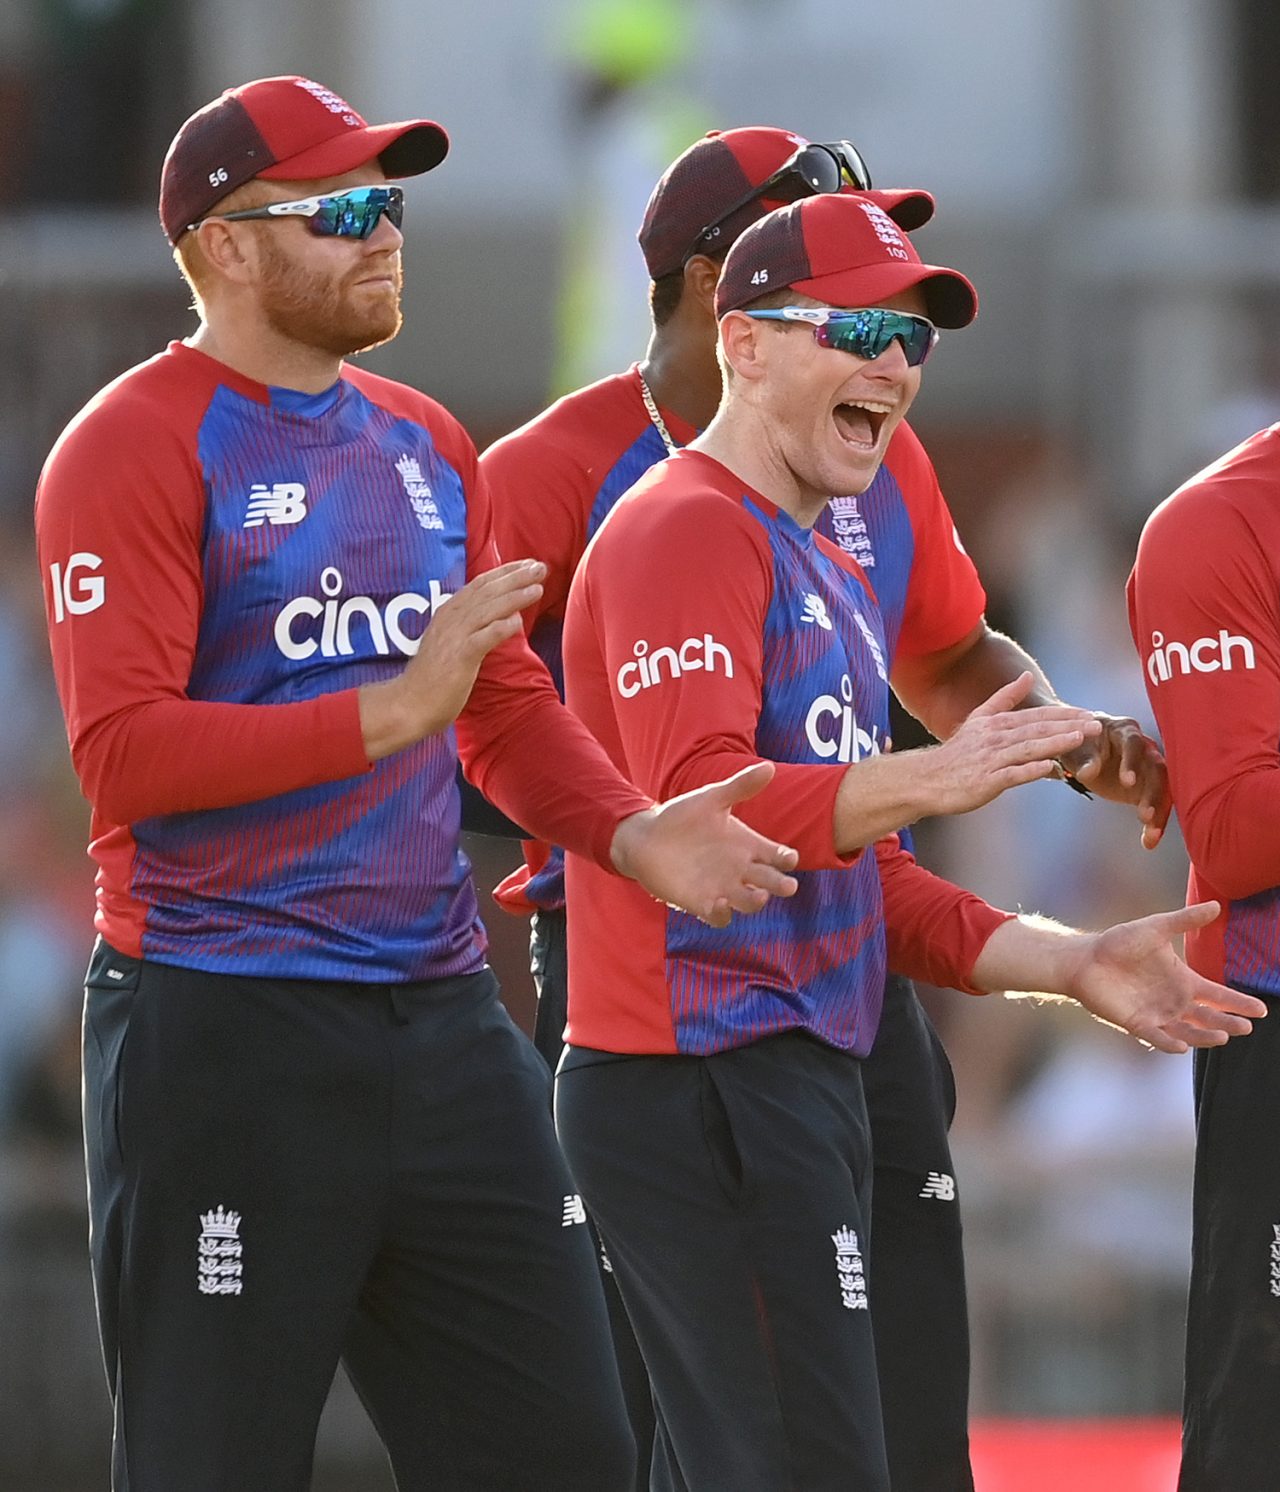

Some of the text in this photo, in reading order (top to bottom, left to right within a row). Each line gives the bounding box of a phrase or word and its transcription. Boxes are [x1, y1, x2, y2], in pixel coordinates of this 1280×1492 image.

[208, 166, 229, 188] 56
[885, 246, 909, 261] 100
[750, 269, 769, 286] 45
[50, 552, 105, 624] IG
[617, 633, 733, 698] cinch
